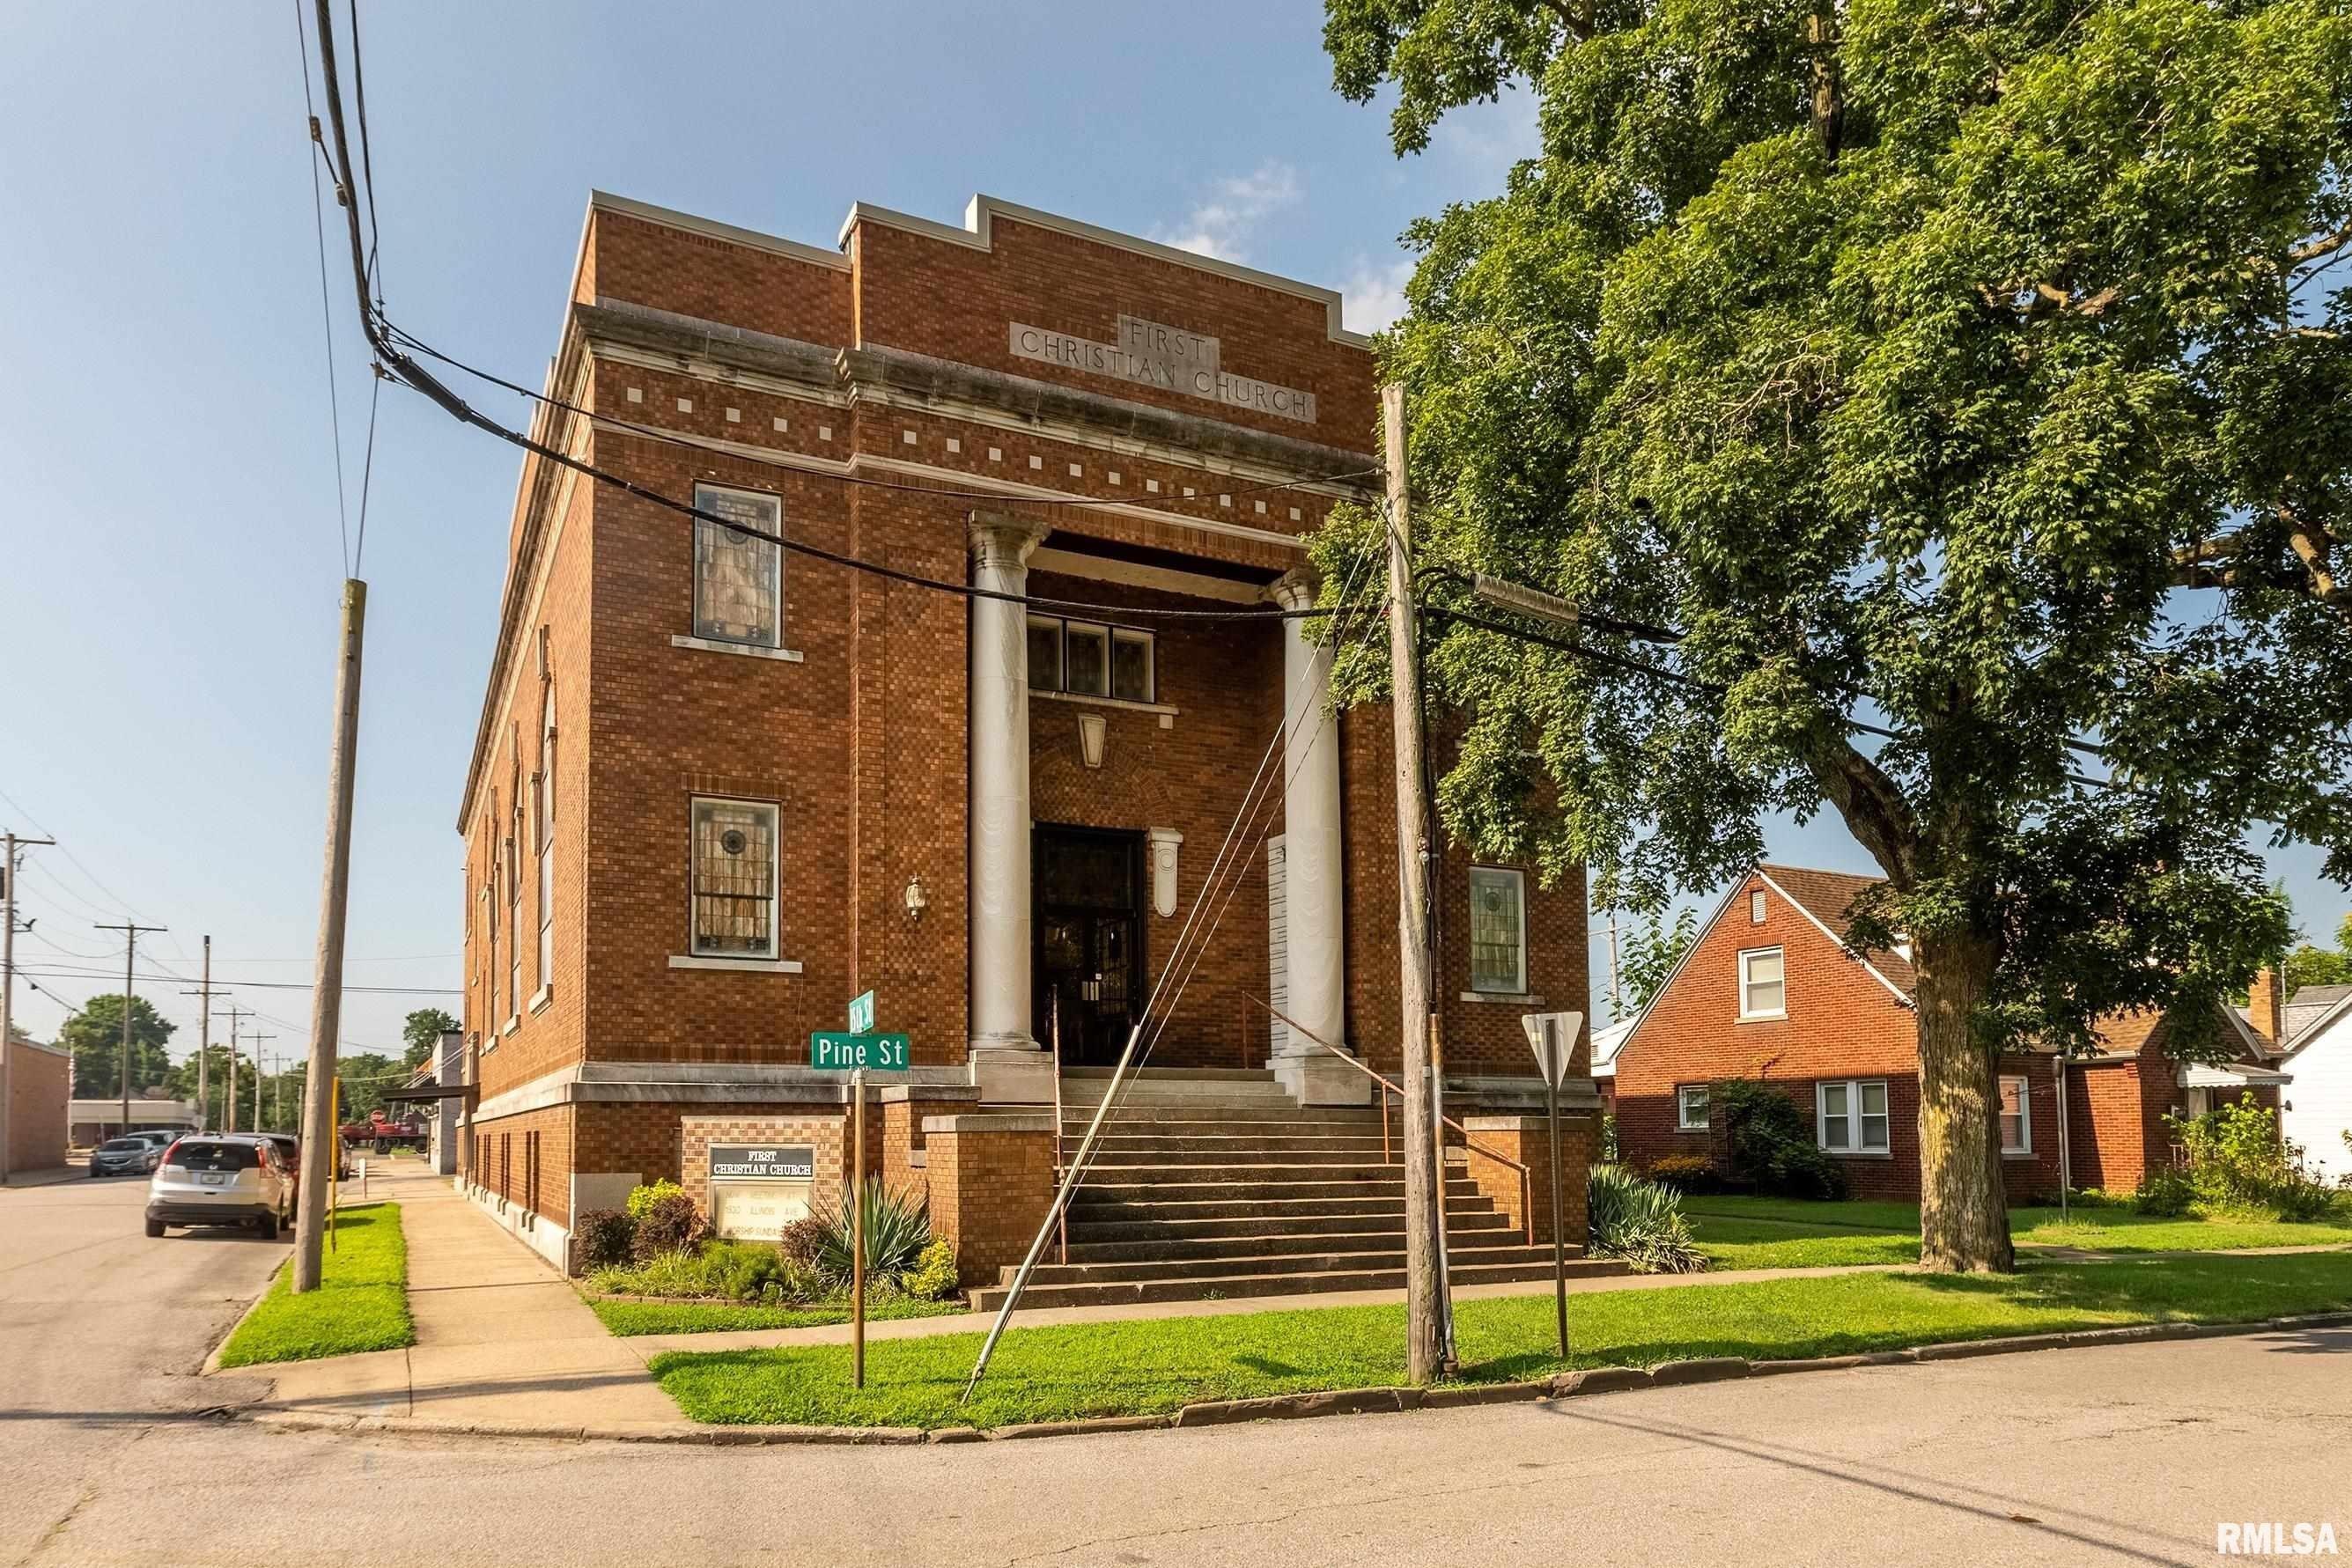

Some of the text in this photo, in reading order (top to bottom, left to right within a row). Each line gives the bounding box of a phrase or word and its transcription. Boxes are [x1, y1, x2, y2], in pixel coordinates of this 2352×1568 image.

[1131, 322, 1205, 360] FIRST
[1021, 330, 1307, 416] CHRISTIAN CHURCH
[819, 1039, 903, 1064] Pine St
[748, 1151, 777, 1161] FIRST
[713, 1163, 812, 1175] CHRISTIAN CHURCH
